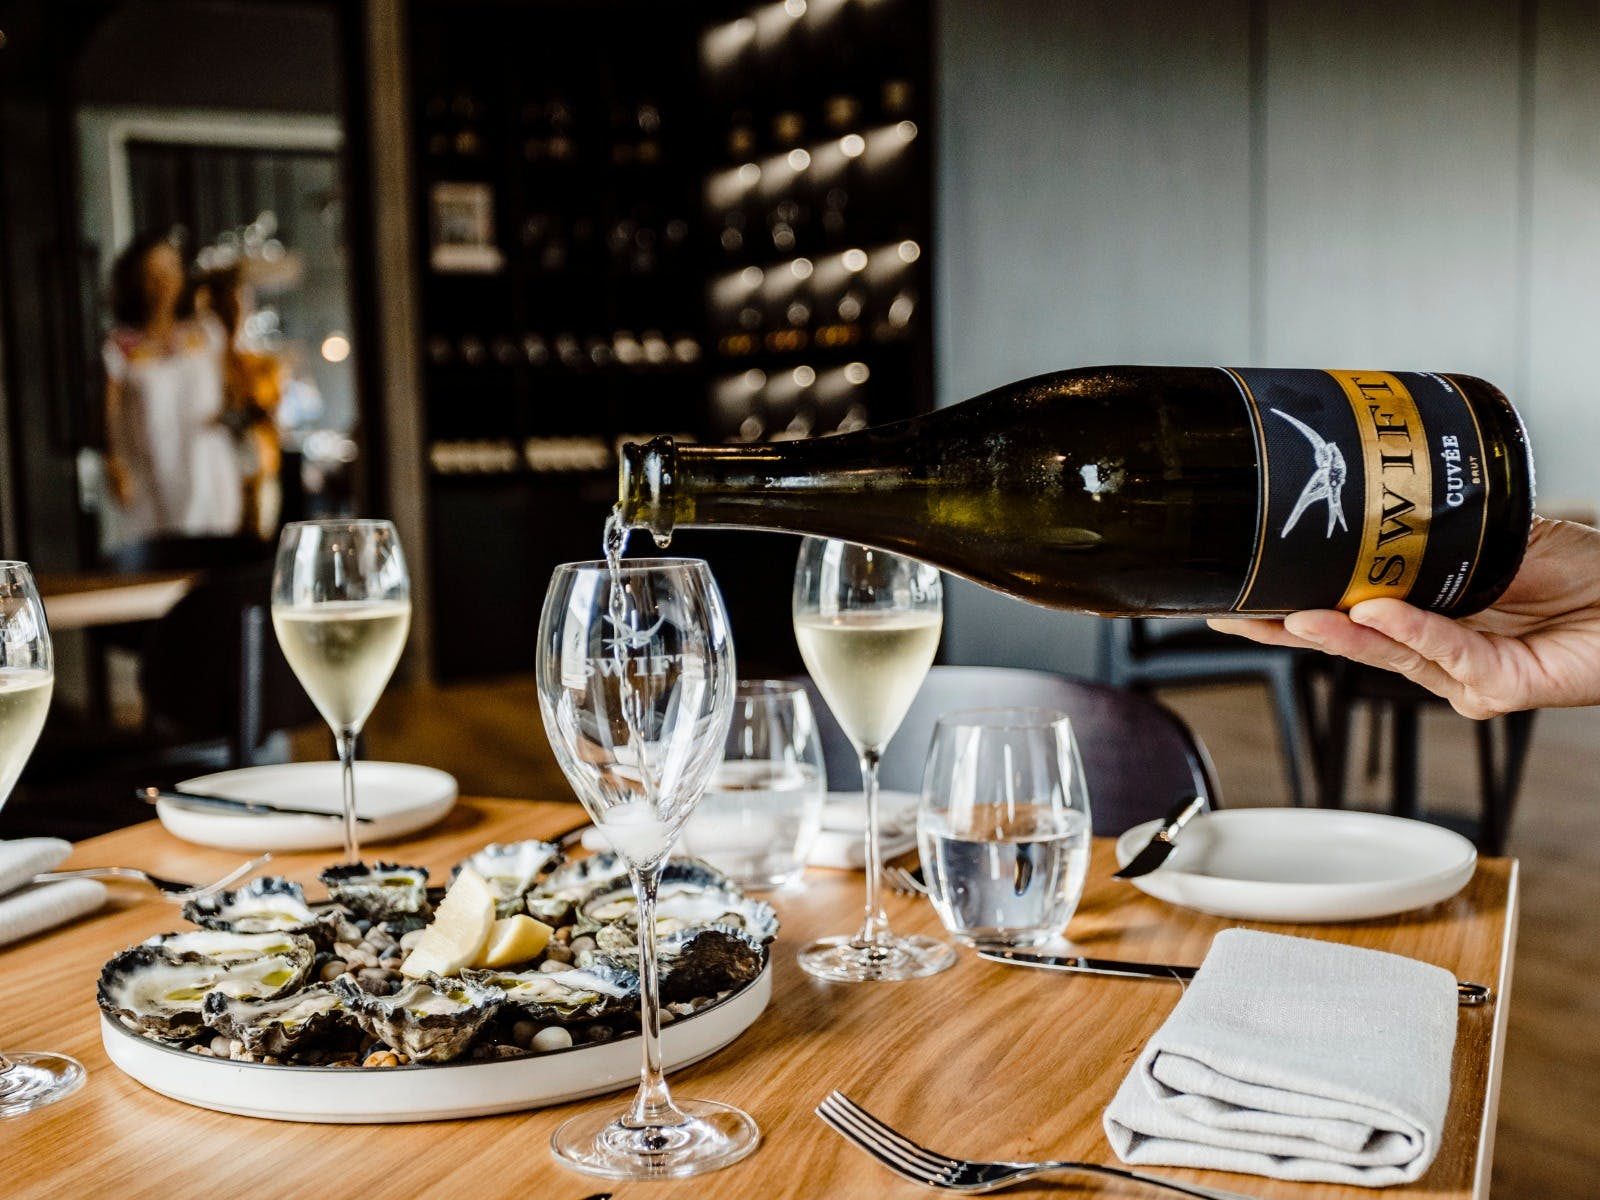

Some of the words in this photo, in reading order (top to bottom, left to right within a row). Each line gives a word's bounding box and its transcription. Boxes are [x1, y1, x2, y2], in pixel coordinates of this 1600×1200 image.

[1351, 376, 1416, 587] SWIFT
[1440, 434, 1464, 507] CUVÉE
[1469, 455, 1481, 484] BRUT
